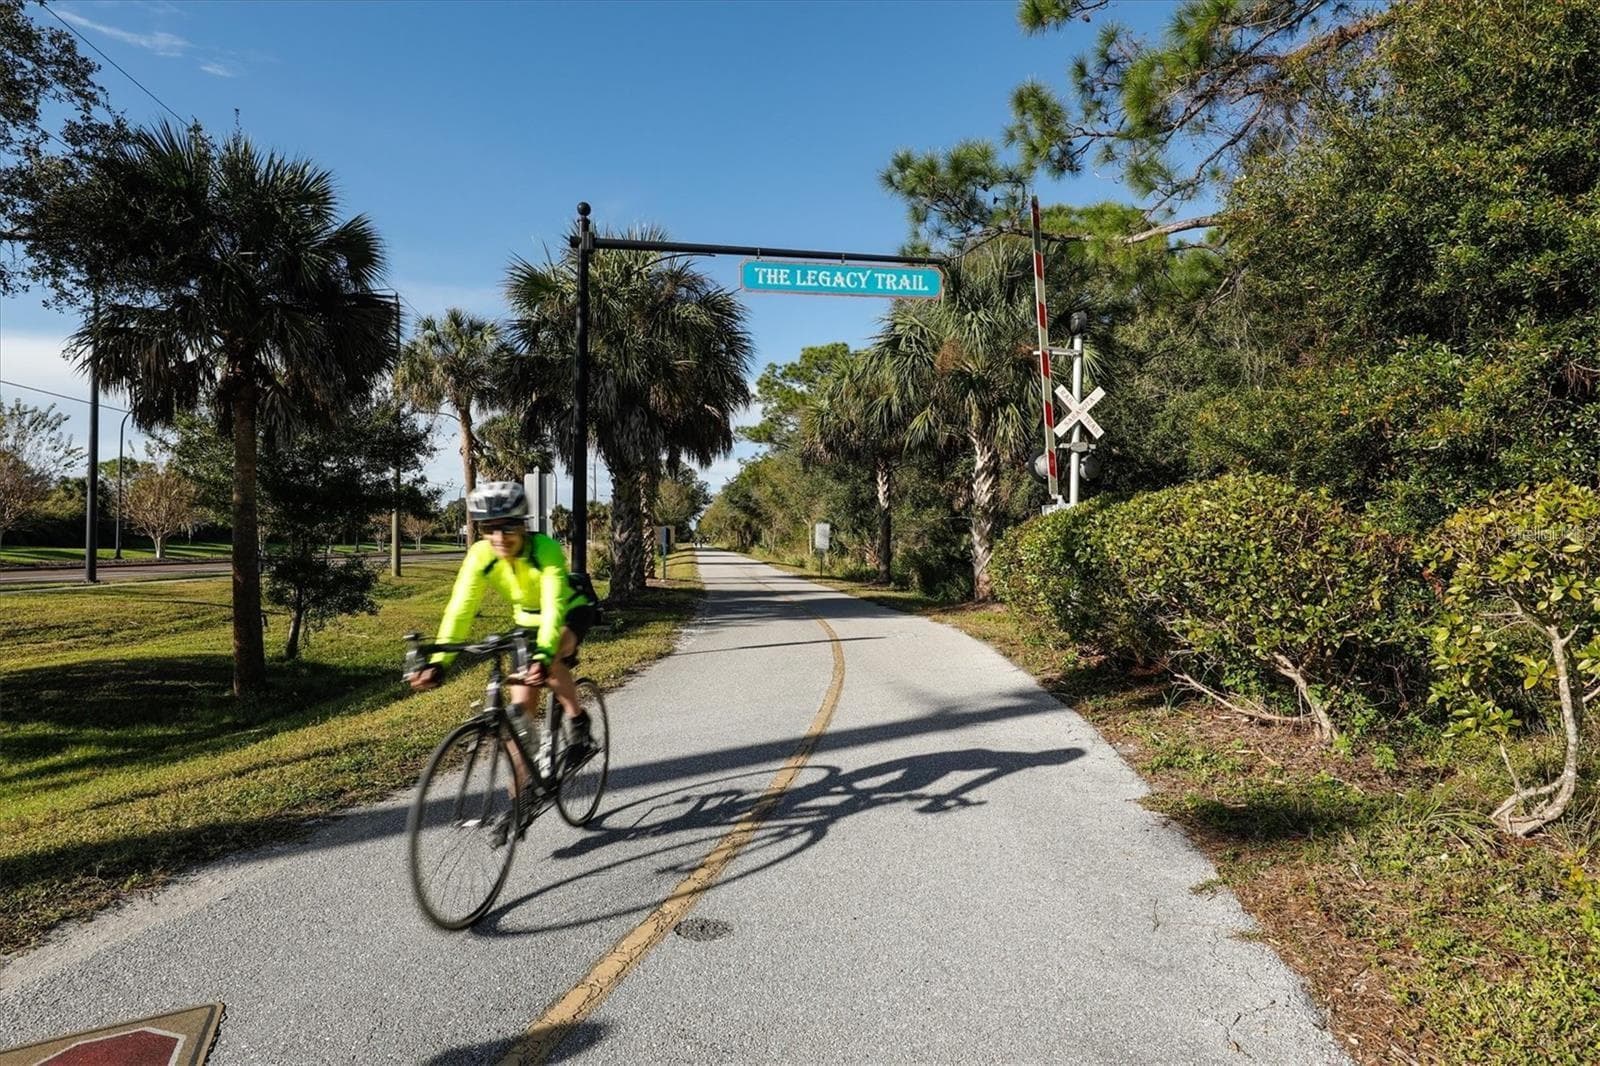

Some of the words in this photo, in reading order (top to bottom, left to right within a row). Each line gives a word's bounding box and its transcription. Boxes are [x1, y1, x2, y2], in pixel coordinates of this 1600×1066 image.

[754, 267, 791, 286] THE
[795, 269, 871, 289] LEGACY
[874, 273, 929, 291] TRAIL
[1059, 389, 1075, 407] RAIL
[1084, 415, 1102, 437] TRAIL
[1063, 397, 1096, 426] SARASOTA
